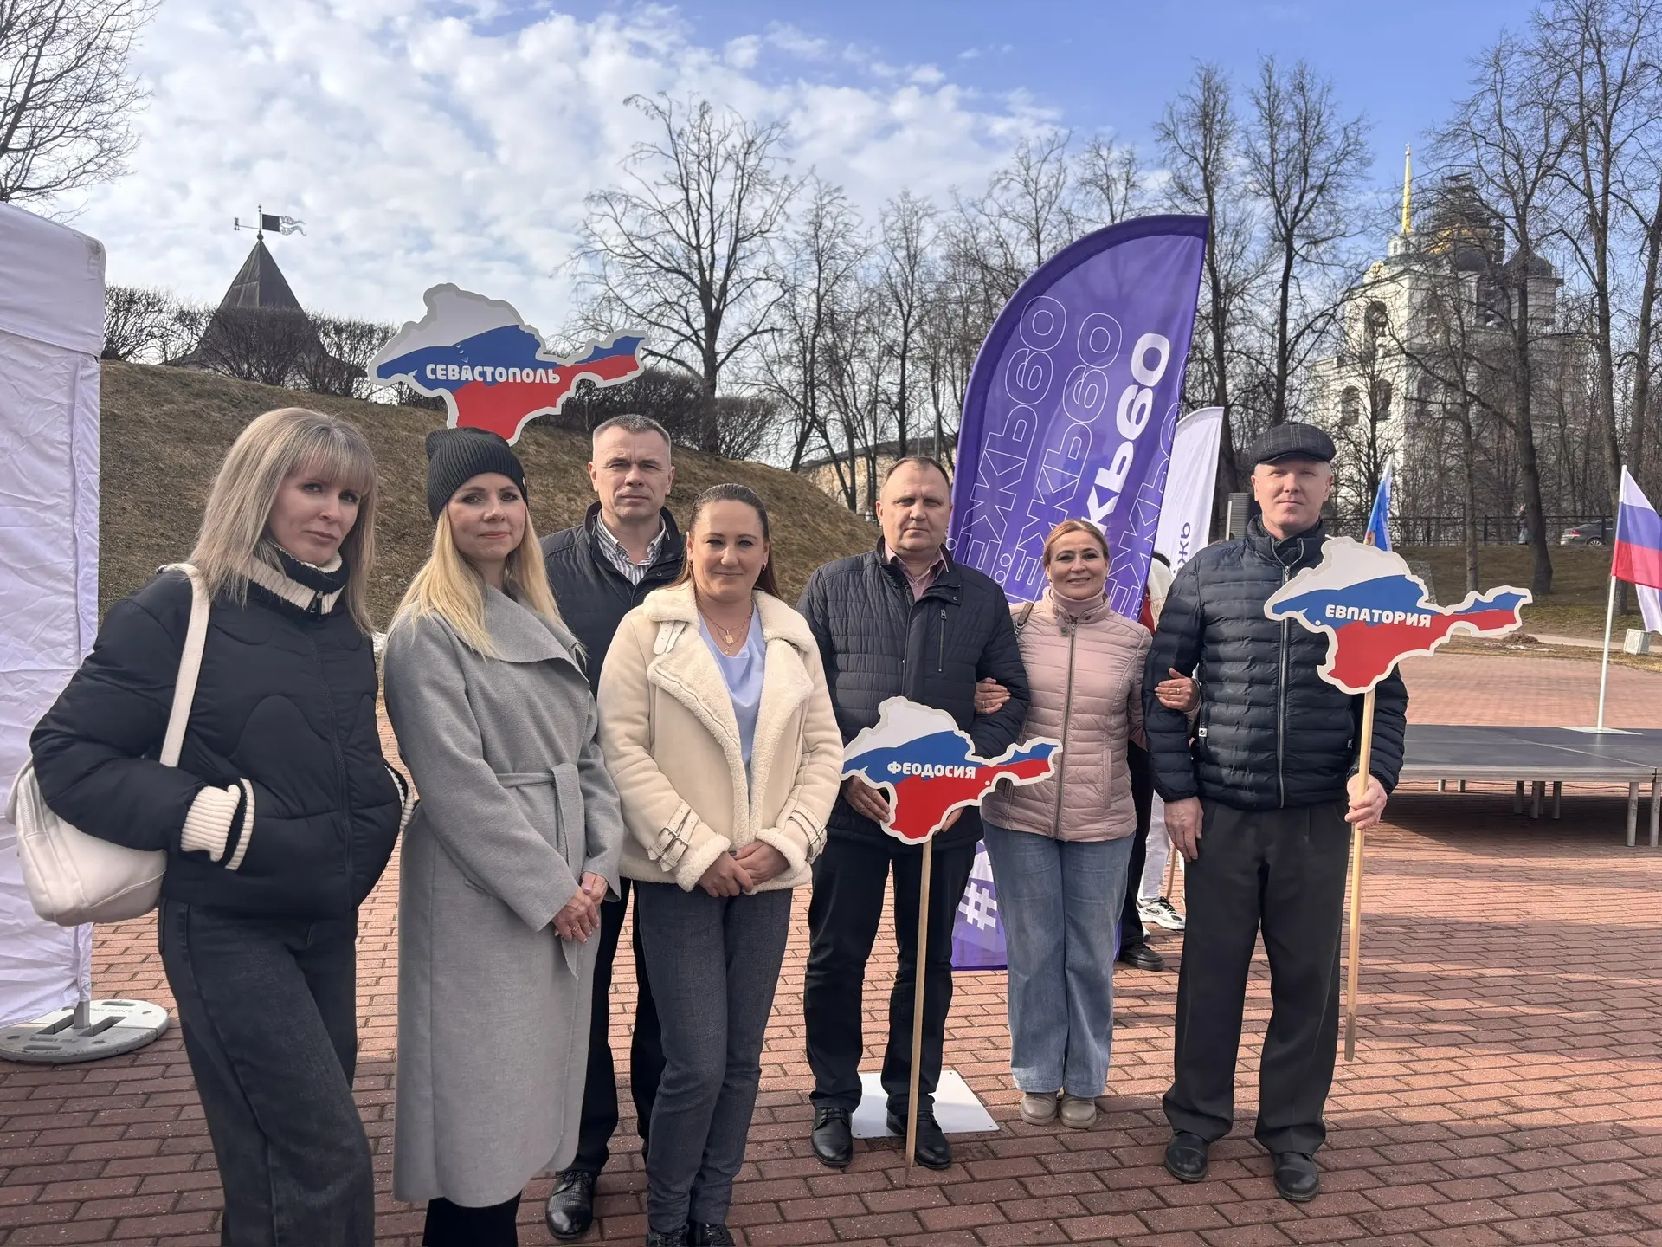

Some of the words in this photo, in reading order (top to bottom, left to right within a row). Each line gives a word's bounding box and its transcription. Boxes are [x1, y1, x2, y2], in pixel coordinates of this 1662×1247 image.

[426, 363, 560, 384] СЕВАСТОПОЛЬ
[1325, 604, 1432, 628] ЕВПАТОРИЯ
[887, 760, 977, 780] ФЕОДОСИЯ
